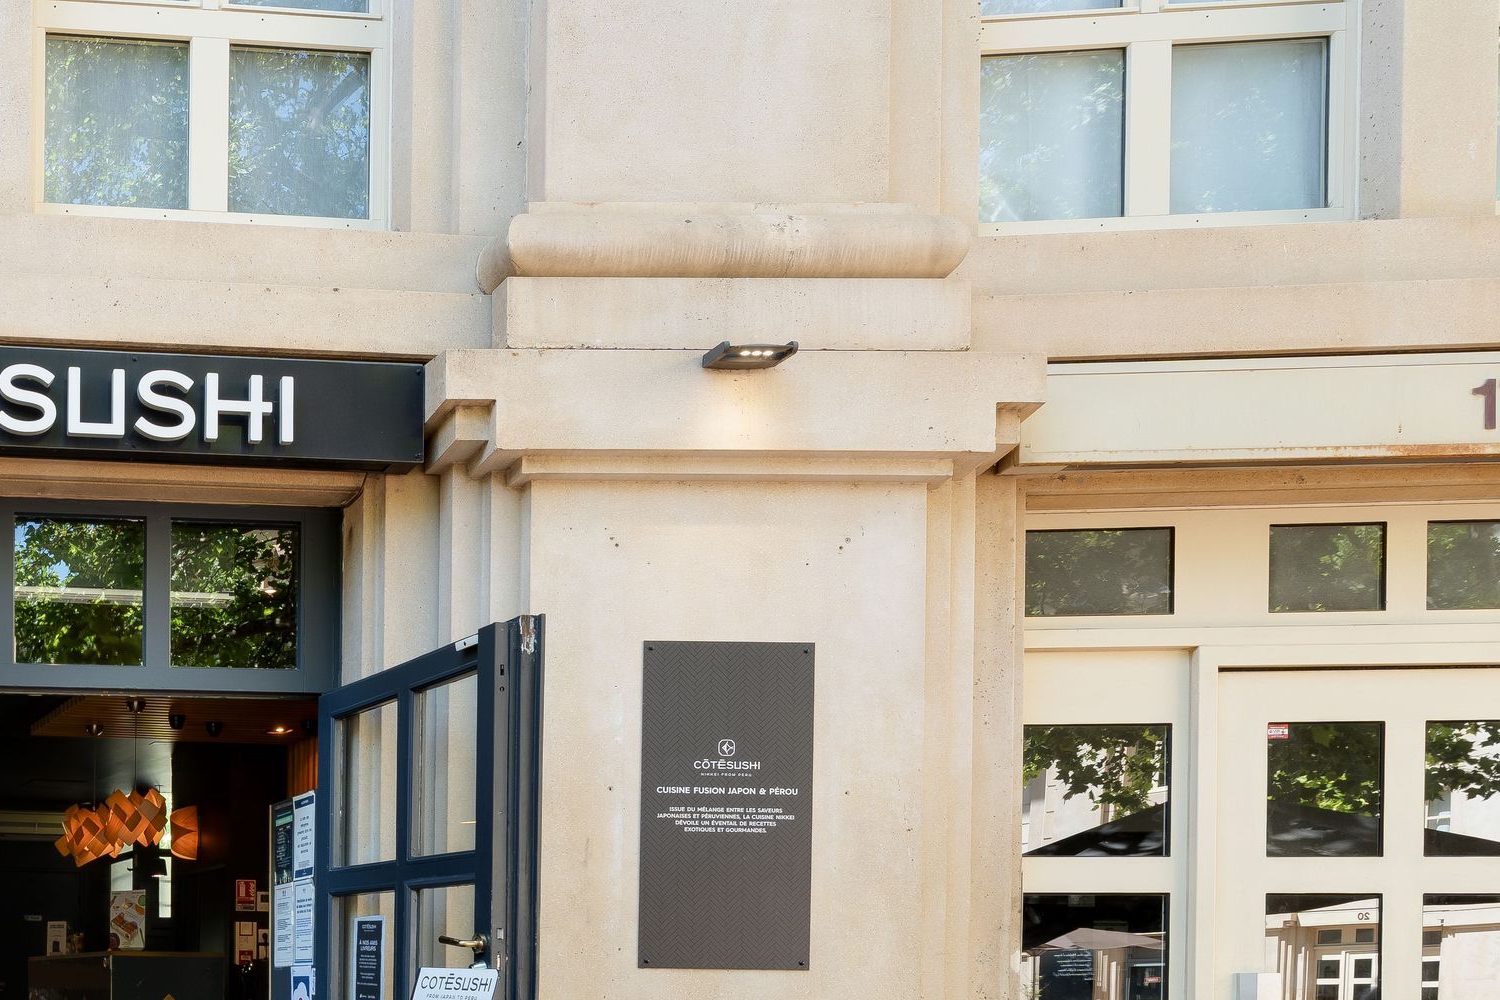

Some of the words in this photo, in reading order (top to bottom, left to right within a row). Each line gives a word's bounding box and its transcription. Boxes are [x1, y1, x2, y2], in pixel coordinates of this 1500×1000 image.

[656, 786, 690, 794] CUISINE
[727, 787, 756, 795] JAPON
[769, 786, 798, 796] PÉROU
